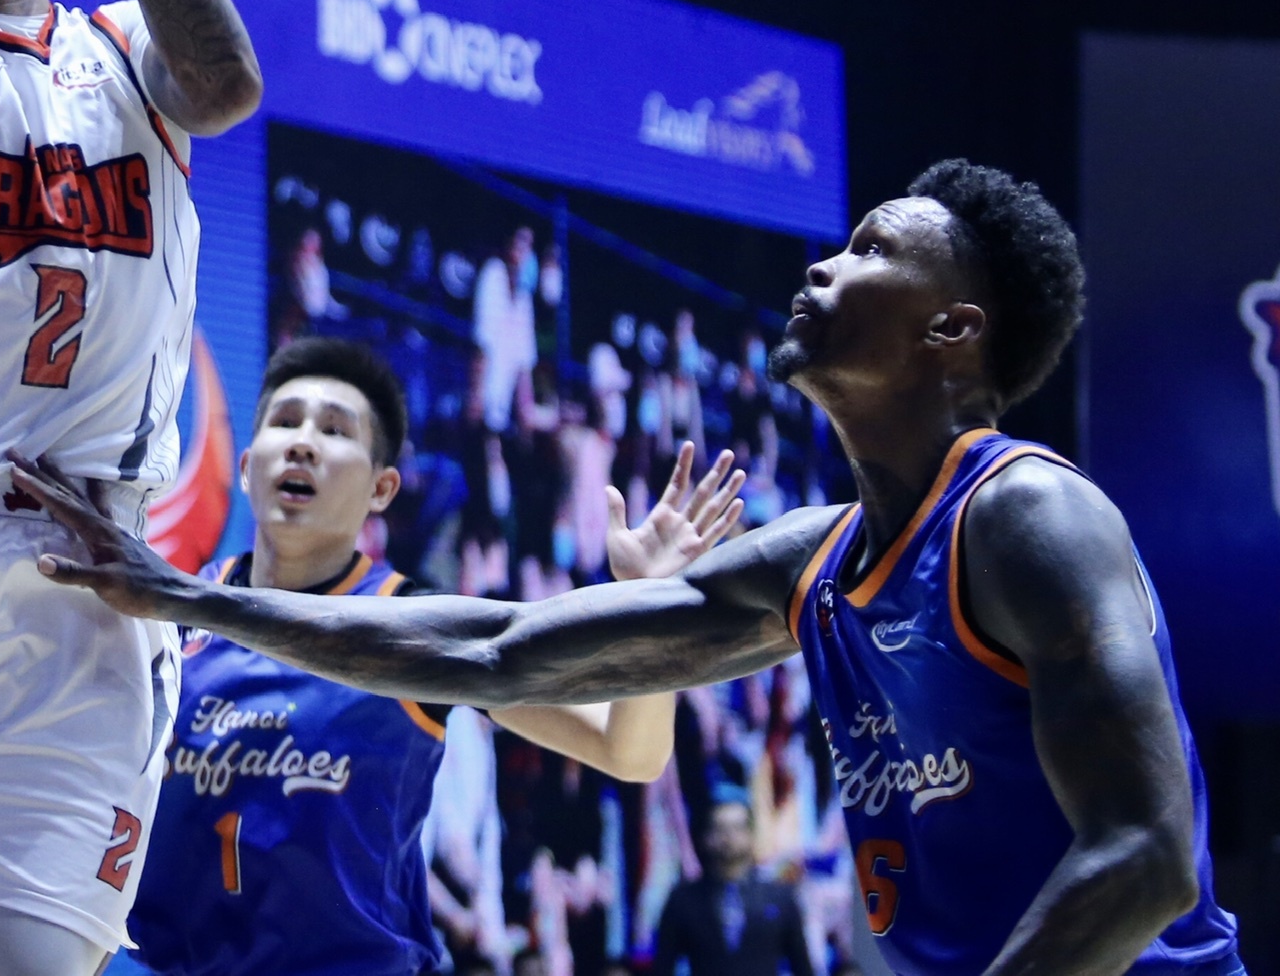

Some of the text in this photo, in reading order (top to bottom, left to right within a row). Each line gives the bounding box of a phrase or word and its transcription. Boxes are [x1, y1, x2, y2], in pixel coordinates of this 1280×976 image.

[21, 263, 88, 390] 2
[191, 696, 297, 736] Hanoi
[163, 735, 351, 797] uffaloes
[96, 805, 143, 893] 2
[214, 811, 241, 895] 1
[855, 838, 906, 936] 6
